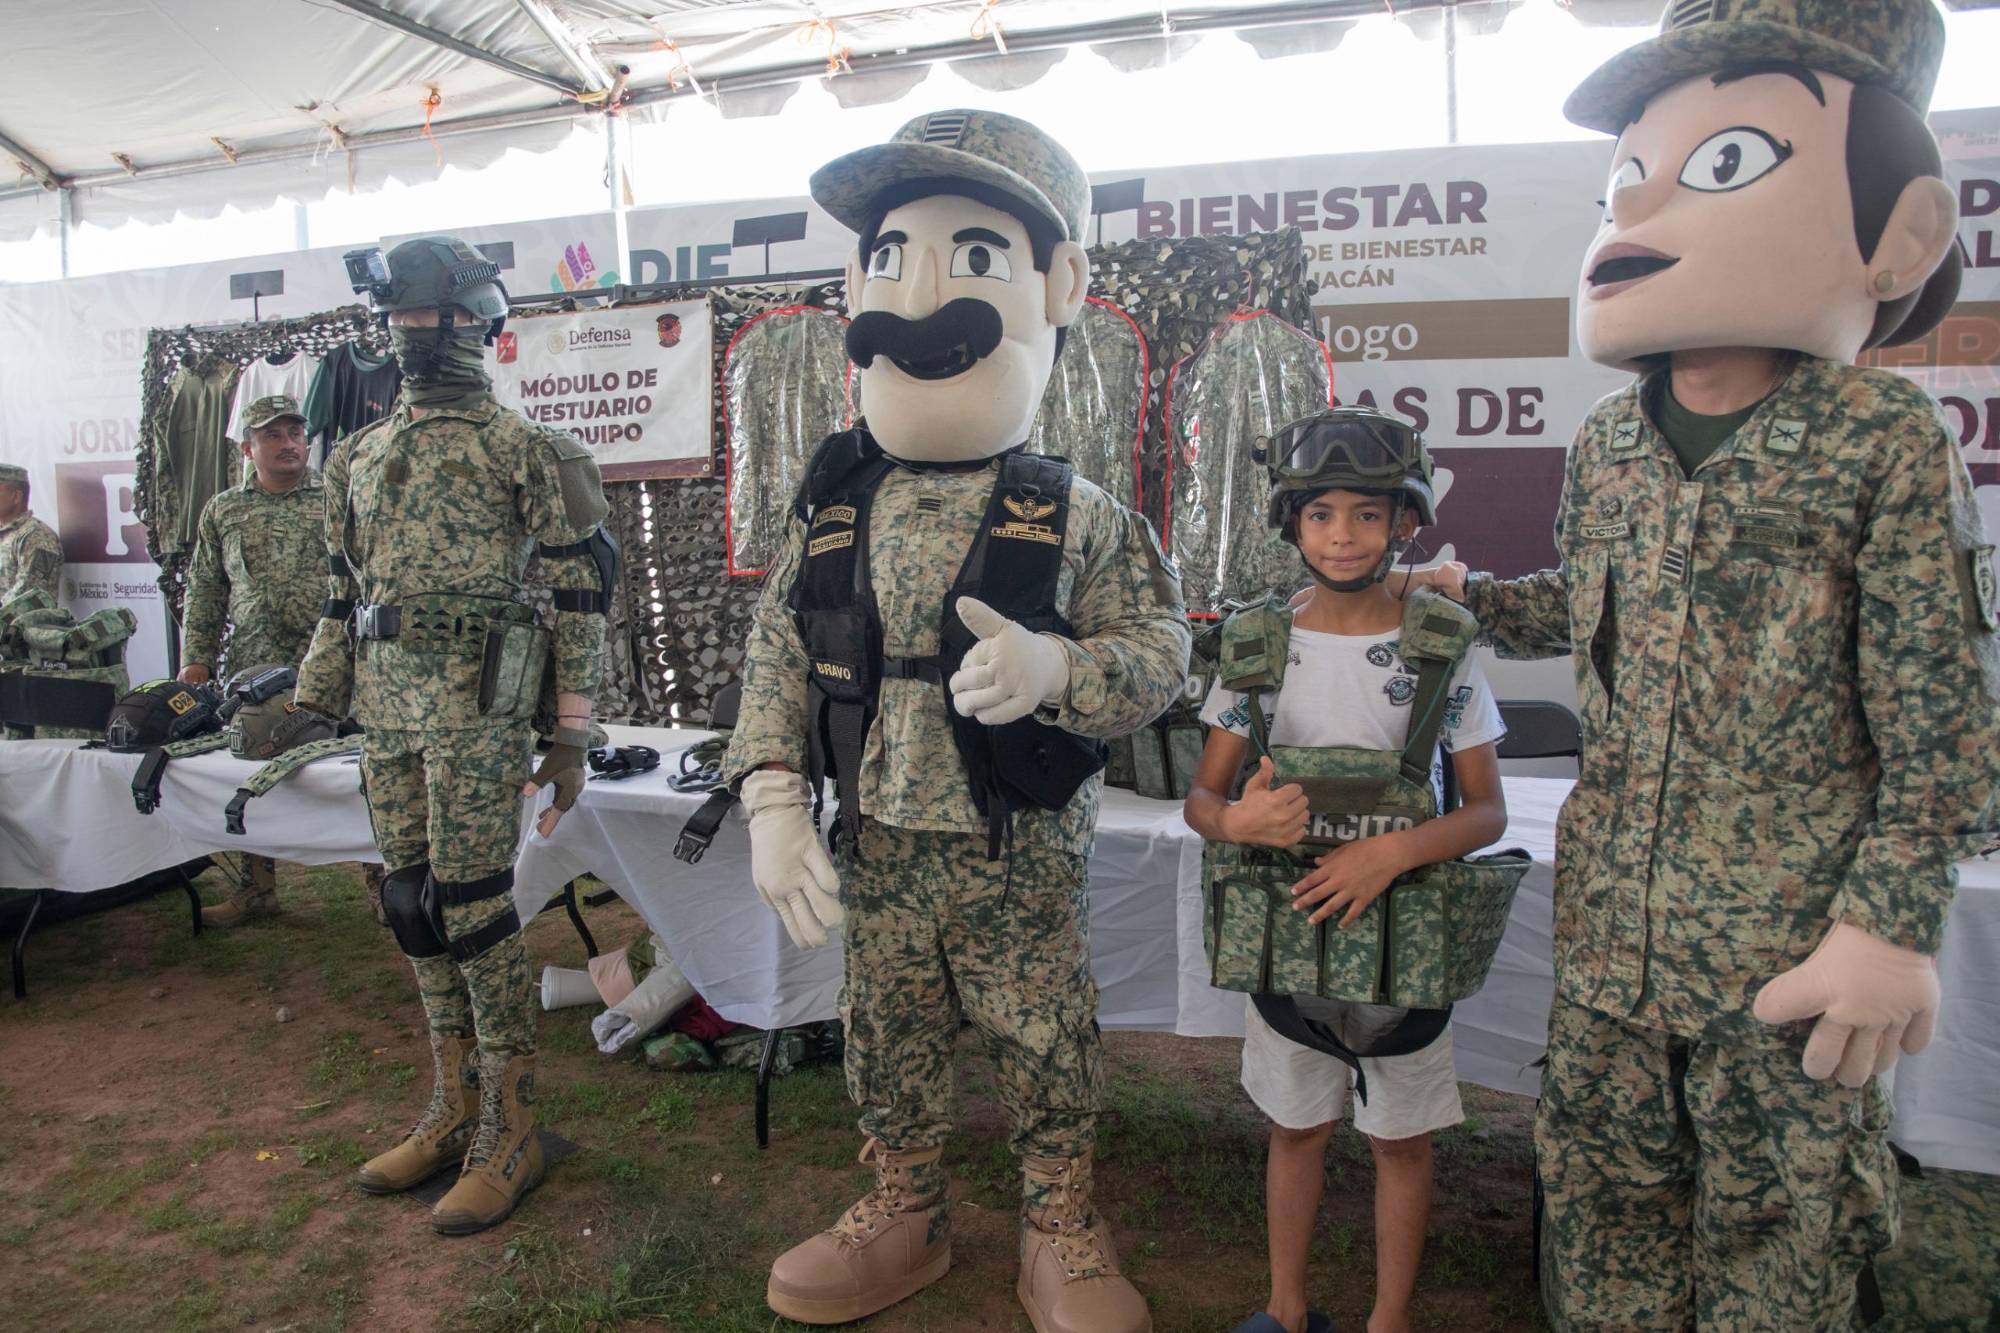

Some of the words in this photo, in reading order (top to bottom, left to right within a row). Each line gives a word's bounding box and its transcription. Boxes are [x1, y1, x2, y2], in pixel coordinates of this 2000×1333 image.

[1136, 180, 1488, 240] BIENESTAR
[1341, 236, 1488, 261] BIENESTAR
[569, 327, 632, 345] Defensa
[520, 372, 620, 399] MÓDULO
[626, 367, 658, 390] DE
[524, 395, 652, 423] VESTUARIO
[1455, 386, 1545, 437] DE
[80, 588, 109, 600] México
[113, 582, 158, 596] Seguridad
[815, 661, 852, 681] BRAVO
